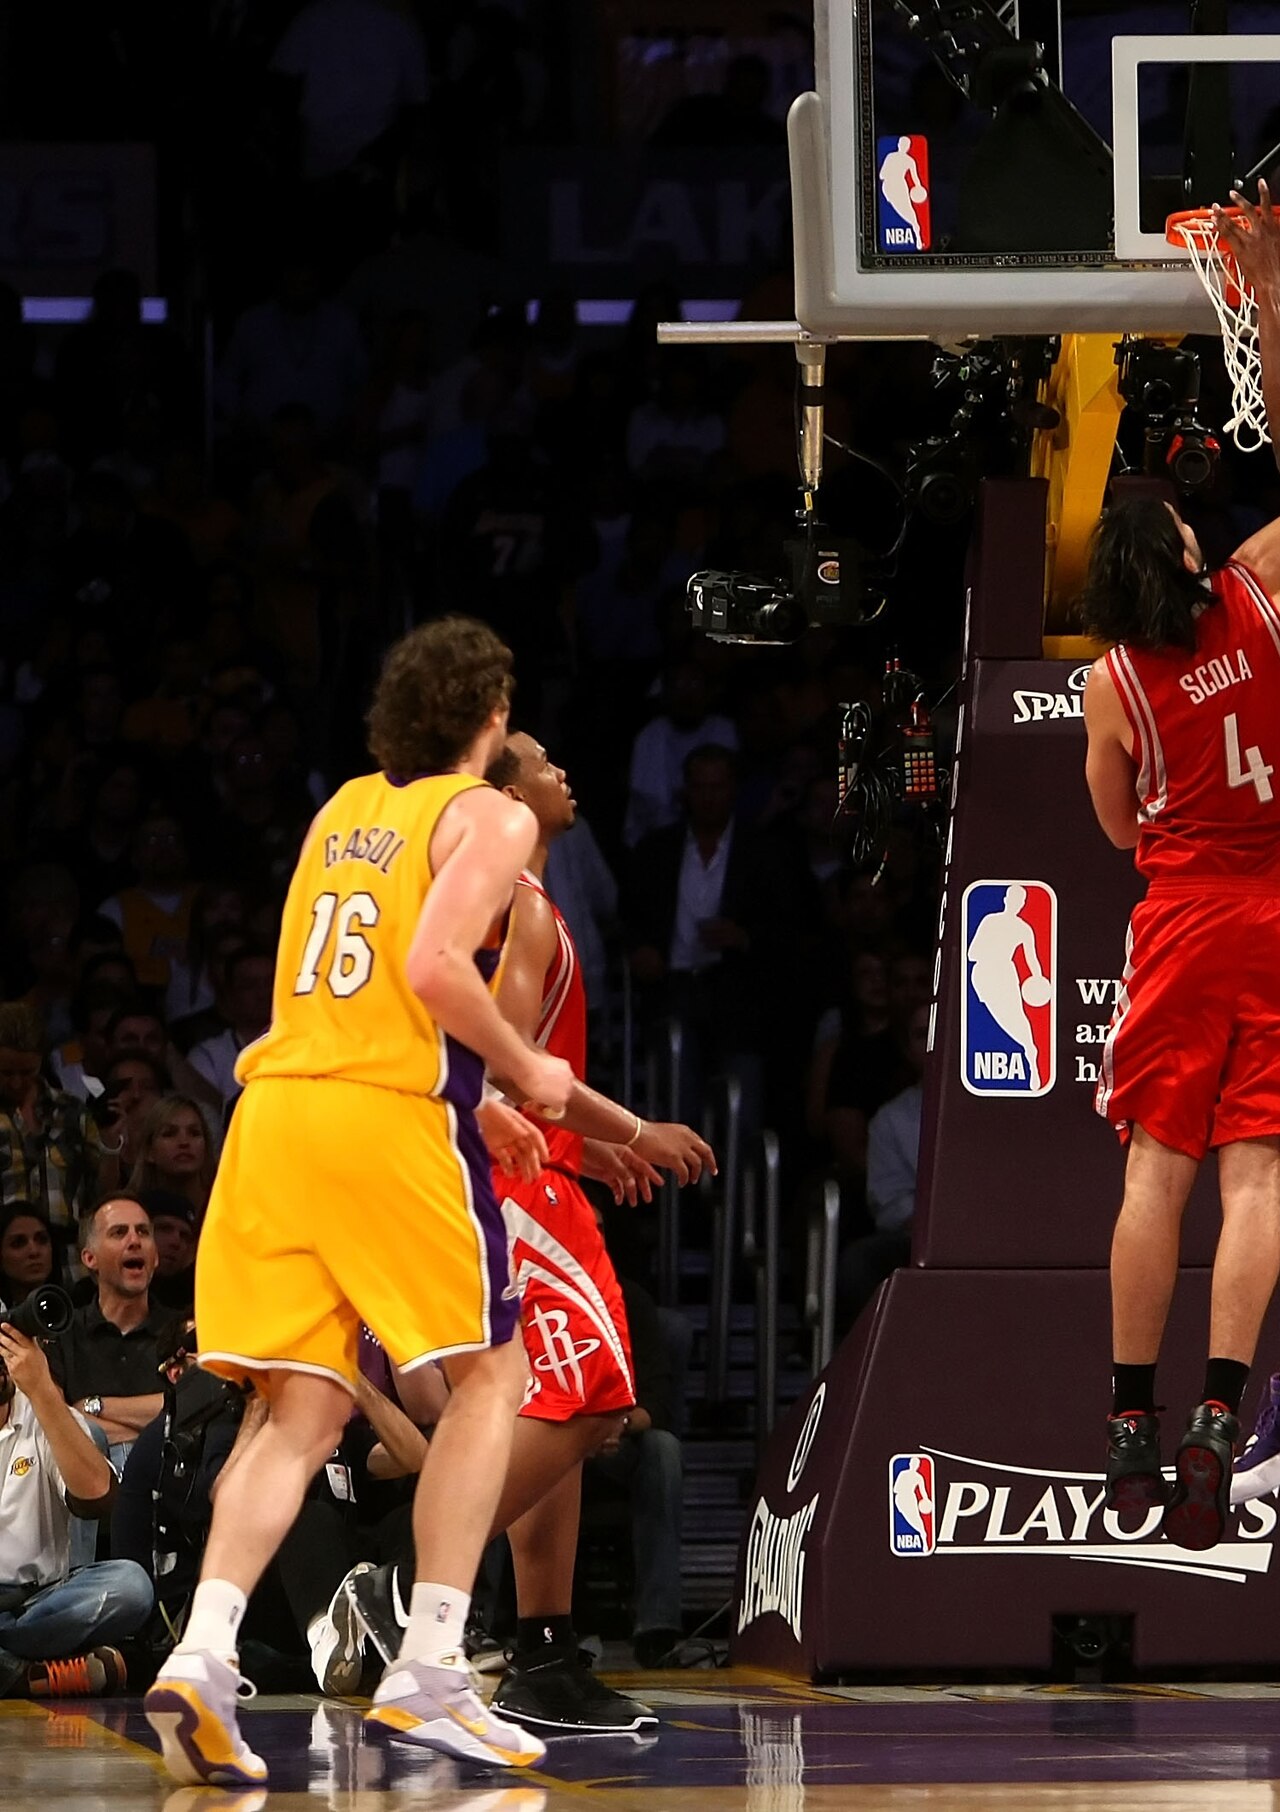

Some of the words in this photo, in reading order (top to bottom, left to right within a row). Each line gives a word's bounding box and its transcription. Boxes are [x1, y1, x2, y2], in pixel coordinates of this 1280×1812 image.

[885, 228, 915, 245] NBA
[1179, 648, 1254, 705] SCOLA
[1222, 712, 1275, 803] 4
[324, 827, 405, 874] GASOL
[293, 891, 381, 999] 16
[974, 1051, 1027, 1080] NBA
[937, 1482, 1280, 1541] PLAYOS
[896, 1534, 922, 1549] NBA
